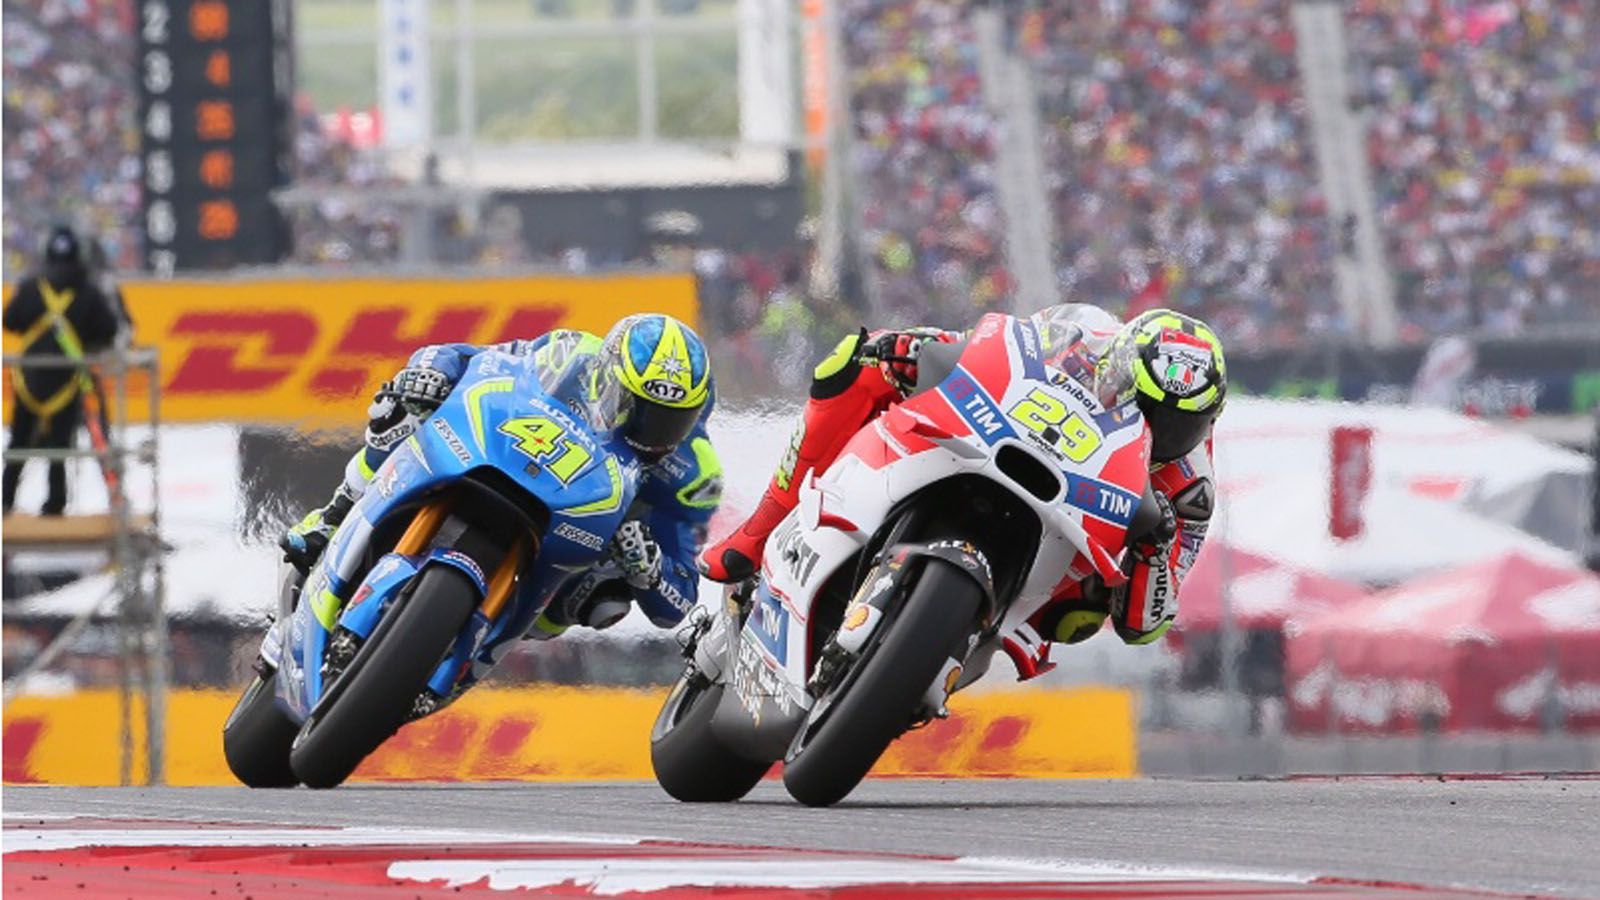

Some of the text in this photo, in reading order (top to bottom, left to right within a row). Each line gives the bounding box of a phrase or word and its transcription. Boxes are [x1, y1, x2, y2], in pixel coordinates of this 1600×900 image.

[144, 2, 170, 44] 2
[145, 50, 173, 93] 3
[147, 100, 172, 142] 4
[147, 200, 176, 244] 6
[964, 393, 1004, 436] TIM
[1007, 386, 1103, 464] 29
[498, 415, 595, 490] 41
[1099, 488, 1132, 518] TIM
